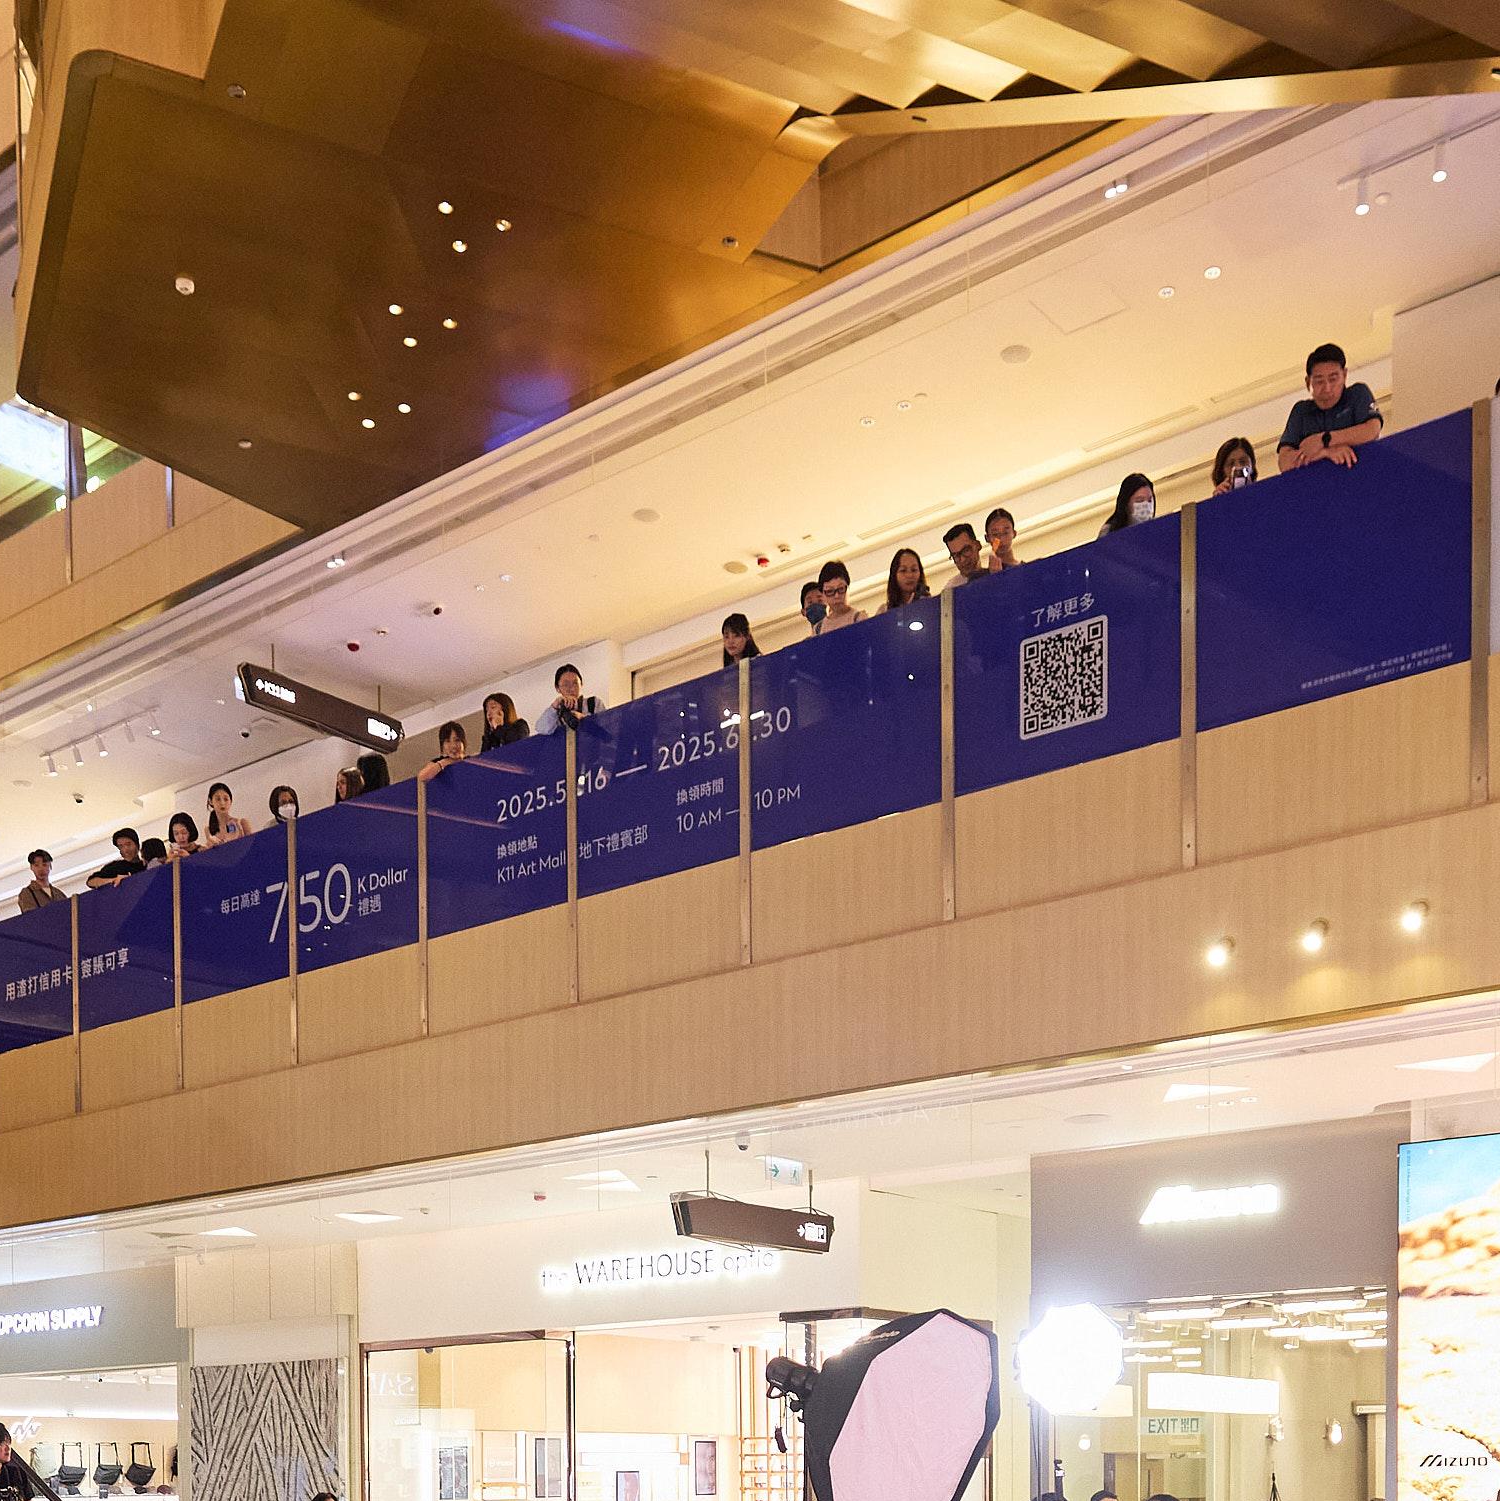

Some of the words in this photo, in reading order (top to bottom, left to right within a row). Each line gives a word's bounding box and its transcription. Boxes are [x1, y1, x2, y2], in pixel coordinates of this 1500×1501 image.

[1031, 592, 1095, 628] 了解更多
[676, 812, 694, 833] 10
[698, 808, 722, 829] AM
[754, 790, 773, 811] 10
[778, 785, 801, 805] PM
[497, 866, 515, 884] K11
[517, 860, 537, 879] Art
[539, 852, 567, 872] Mall
[578, 825, 649, 861] 地下禮賓部
[266, 863, 351, 943] 750
[357, 876, 367, 895] K
[369, 868, 408, 891] Dollar
[357, 894, 382, 917] 禮遇
[575, 1250, 714, 1284] WAREHOUSE
[51, 1305, 102, 1331] SUPPLY
[1148, 1418, 1179, 1434] EXIT
[1419, 1455, 1488, 1468] MIZUNO
